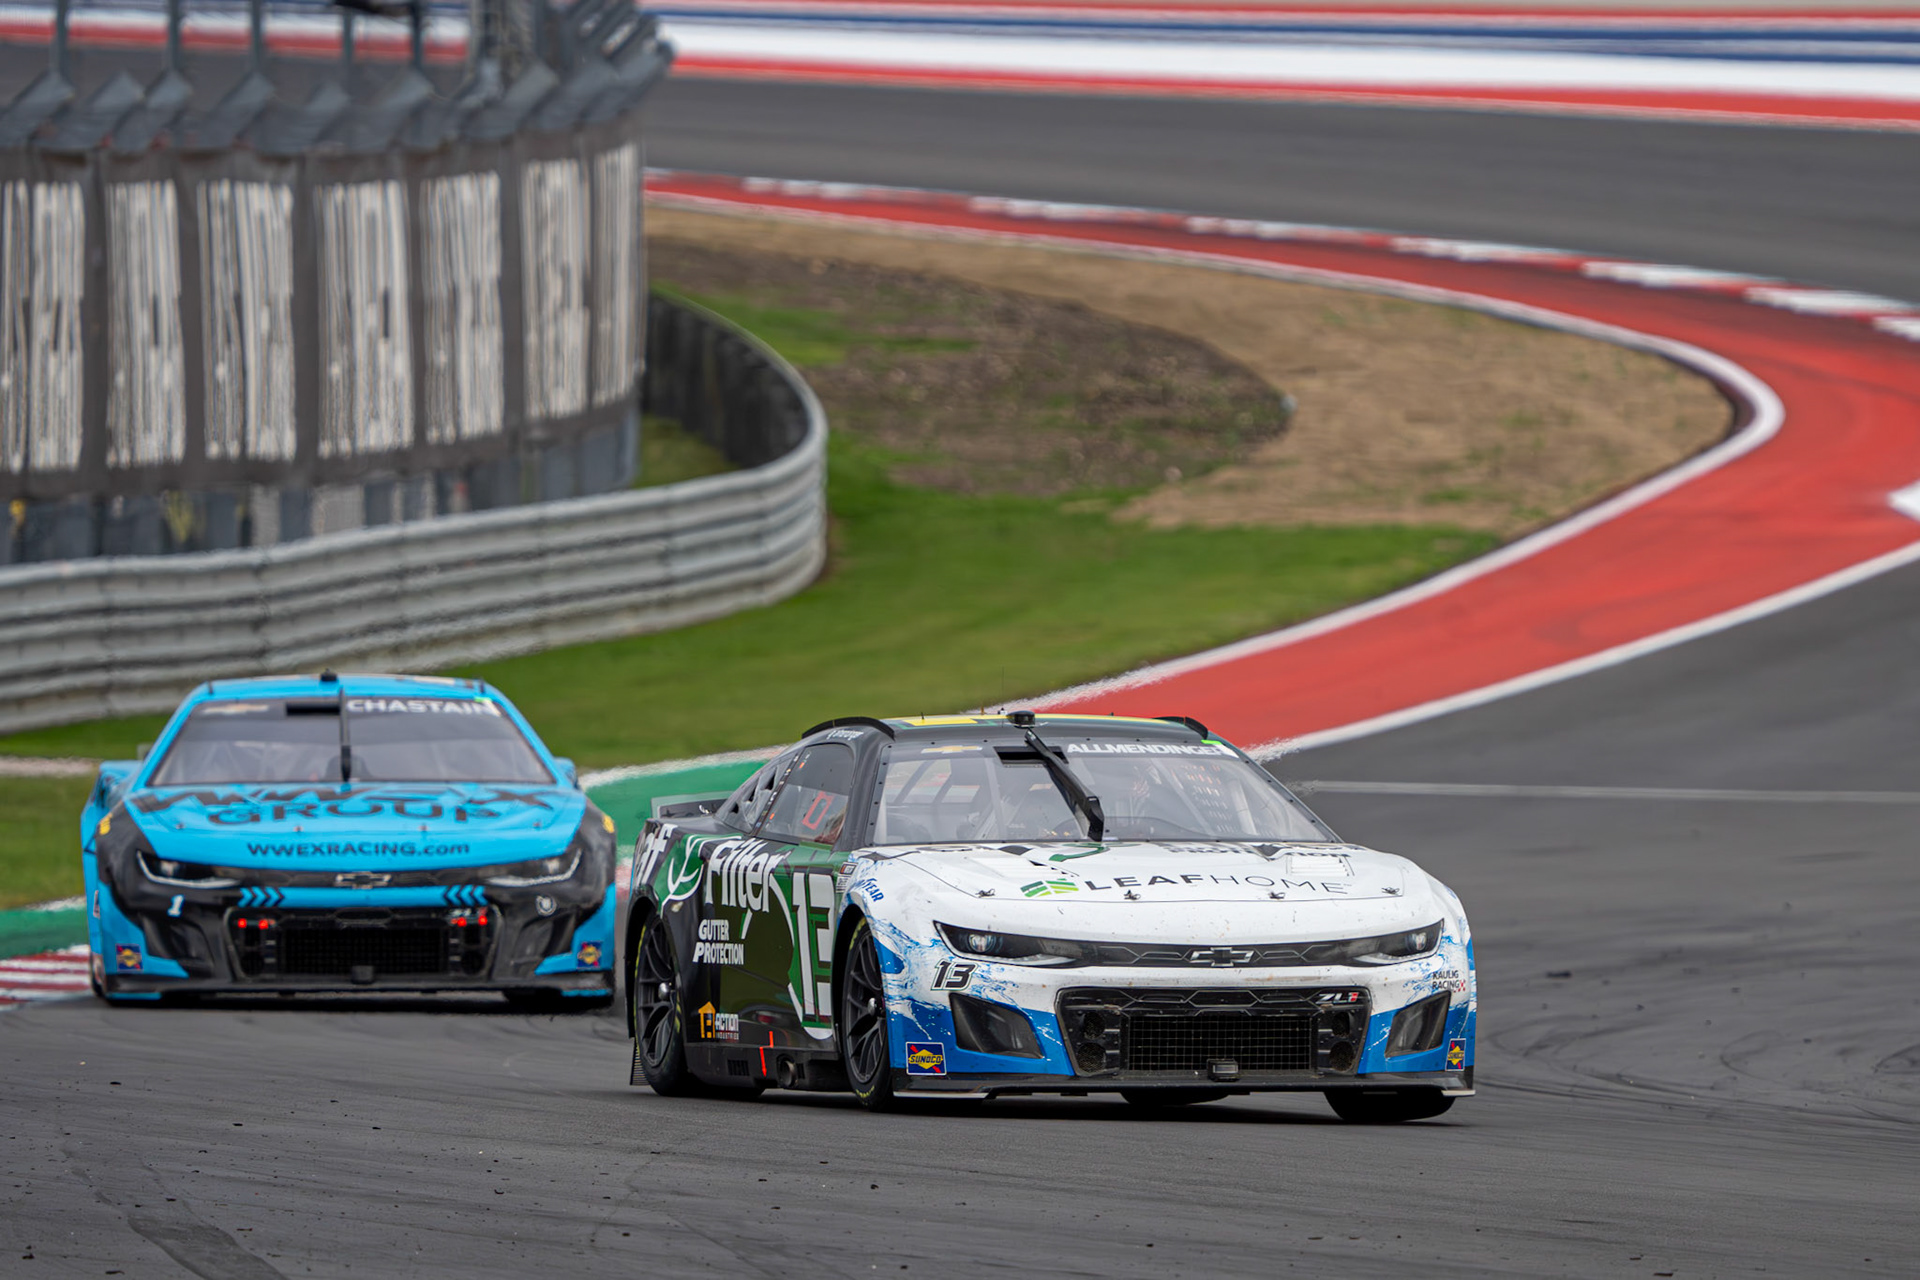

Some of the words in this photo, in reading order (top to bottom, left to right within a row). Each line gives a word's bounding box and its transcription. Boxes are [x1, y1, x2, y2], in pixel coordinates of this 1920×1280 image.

[346, 699, 494, 715] CHASTAIN
[247, 842, 471, 857] WWEXRACING.com
[705, 837, 791, 913] Filter
[167, 894, 184, 916] 1
[698, 919, 730, 941] GUTTER
[692, 942, 744, 965] PROTECTION
[931, 959, 978, 991] 13
[1432, 980, 1460, 990] RACING
[1316, 992, 1359, 1004] ZL1
[909, 1055, 943, 1063] SUNOCO
